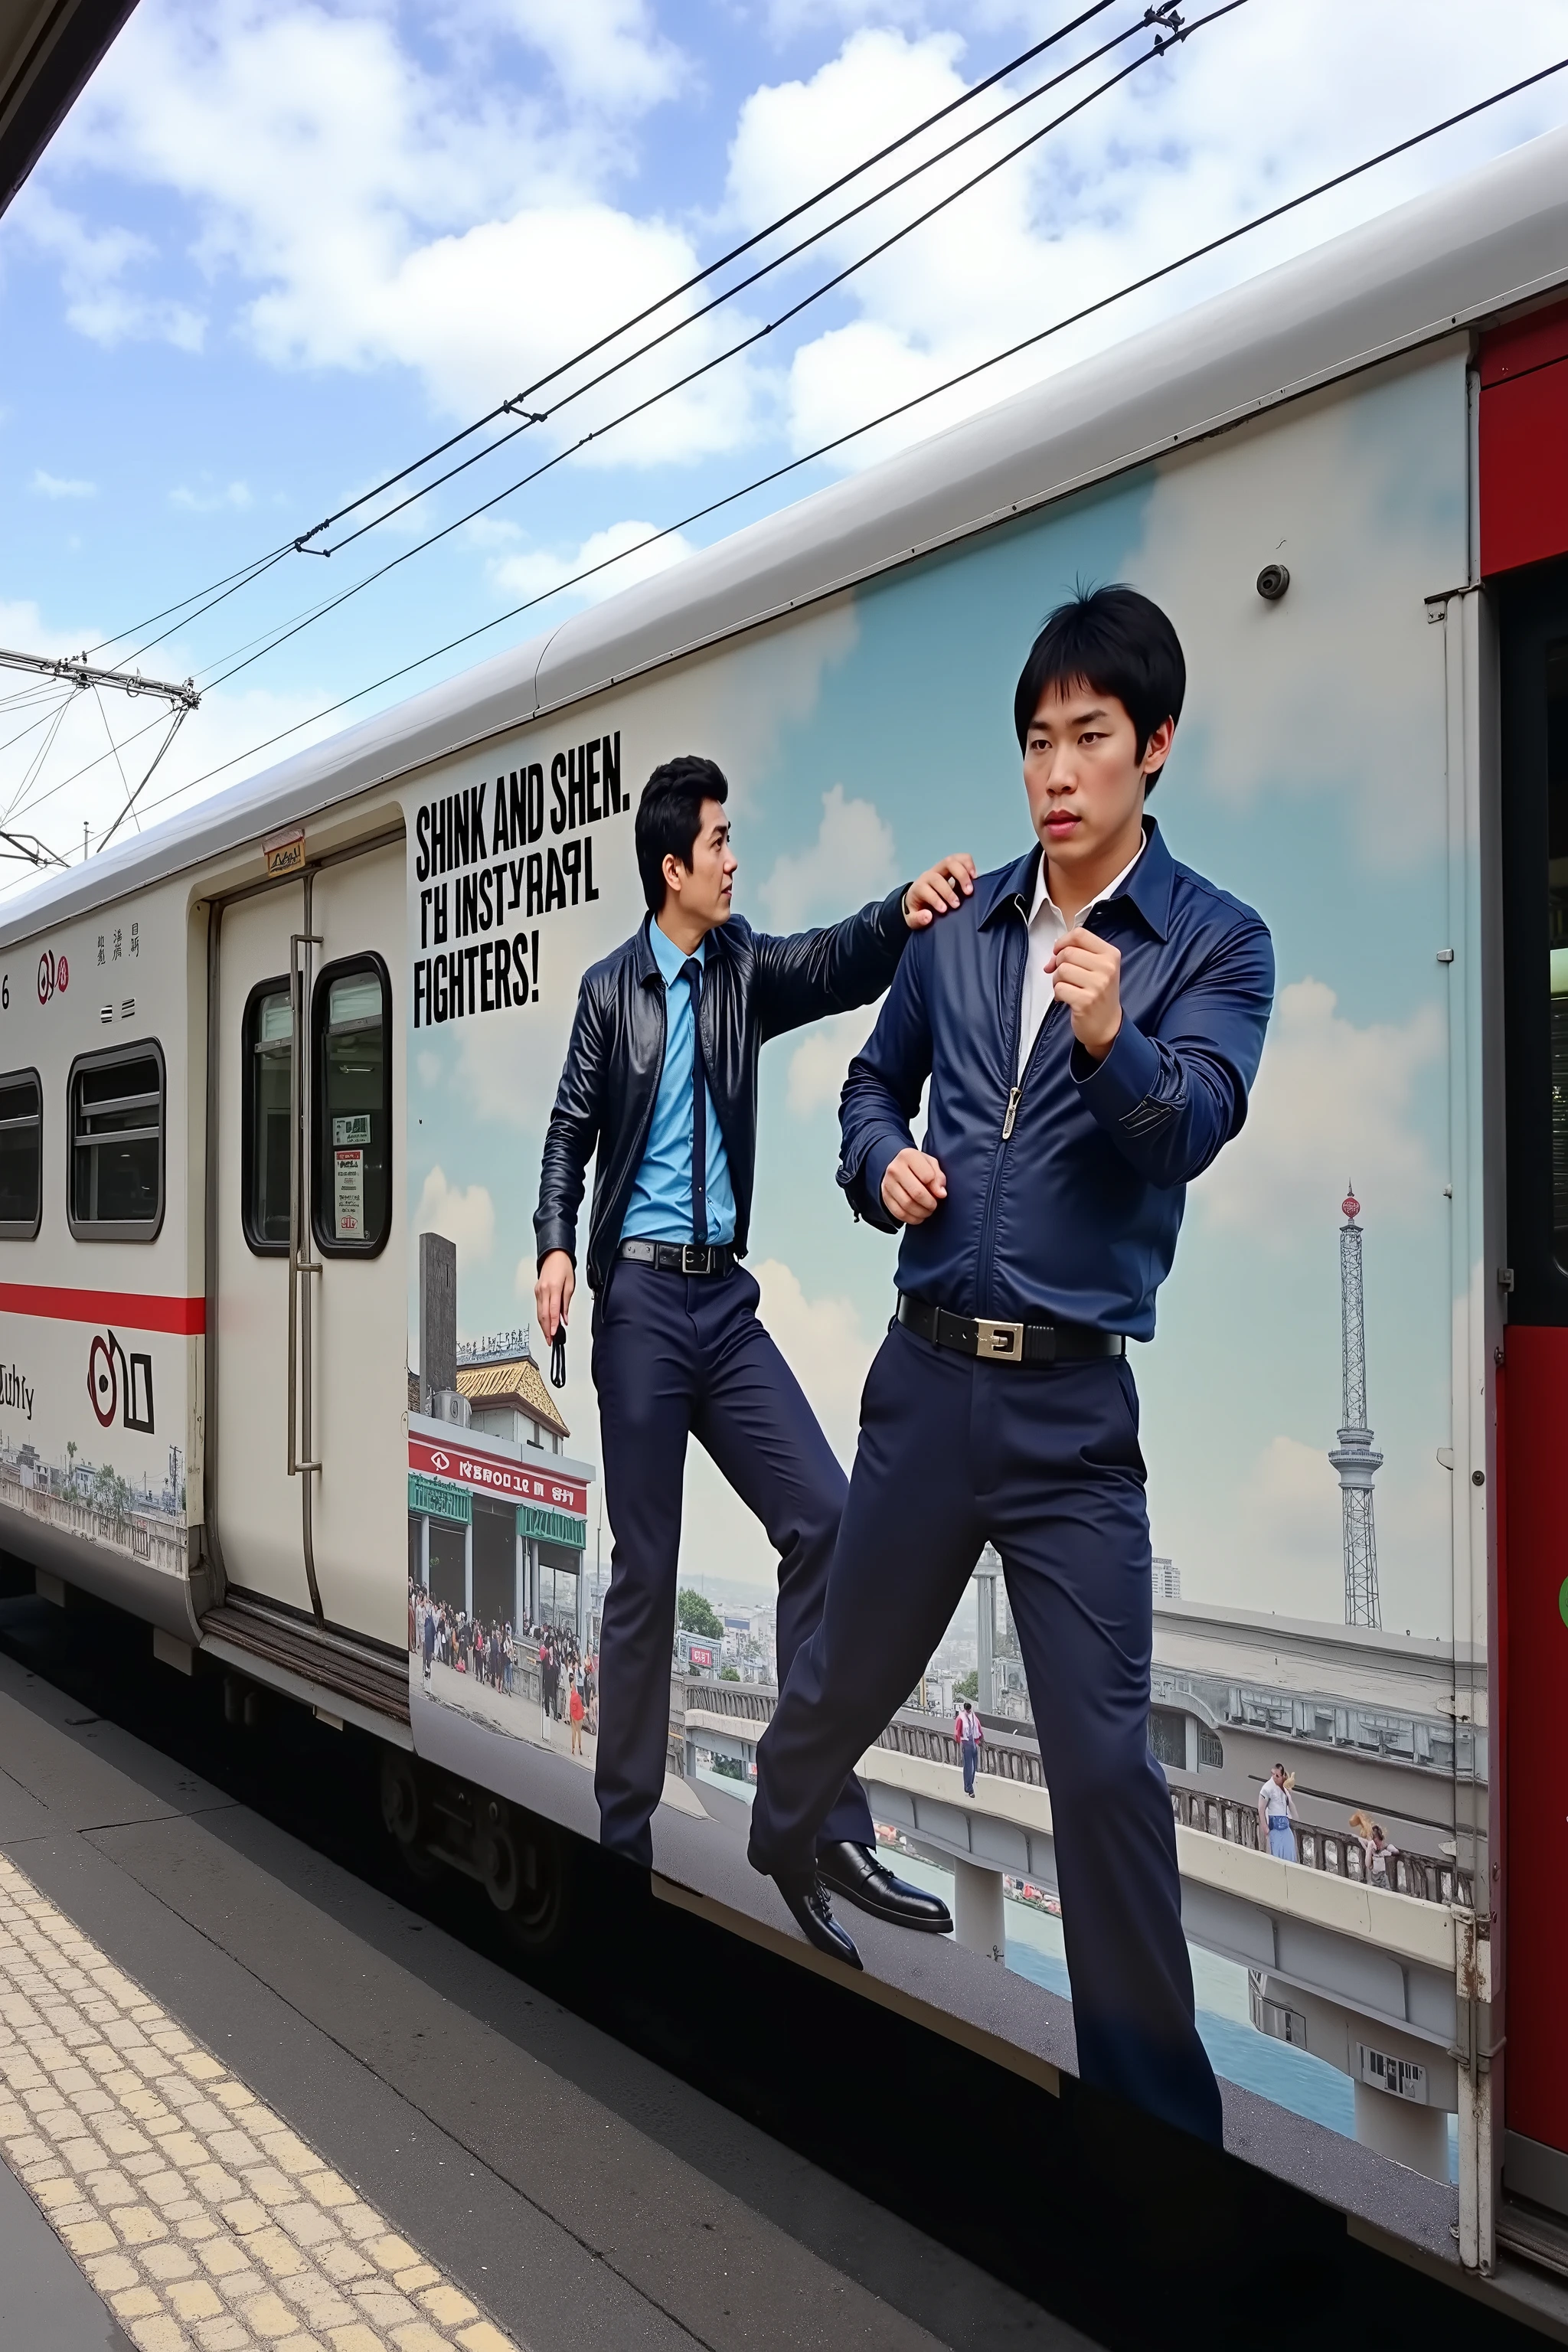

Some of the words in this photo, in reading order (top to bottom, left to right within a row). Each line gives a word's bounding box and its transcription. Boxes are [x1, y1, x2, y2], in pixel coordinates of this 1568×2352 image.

[416, 782, 487, 882] SHINK
[492, 763, 544, 855] AND
[550, 730, 630, 835] SHEN.
[414, 930, 539, 1028] FIGHTERS!
